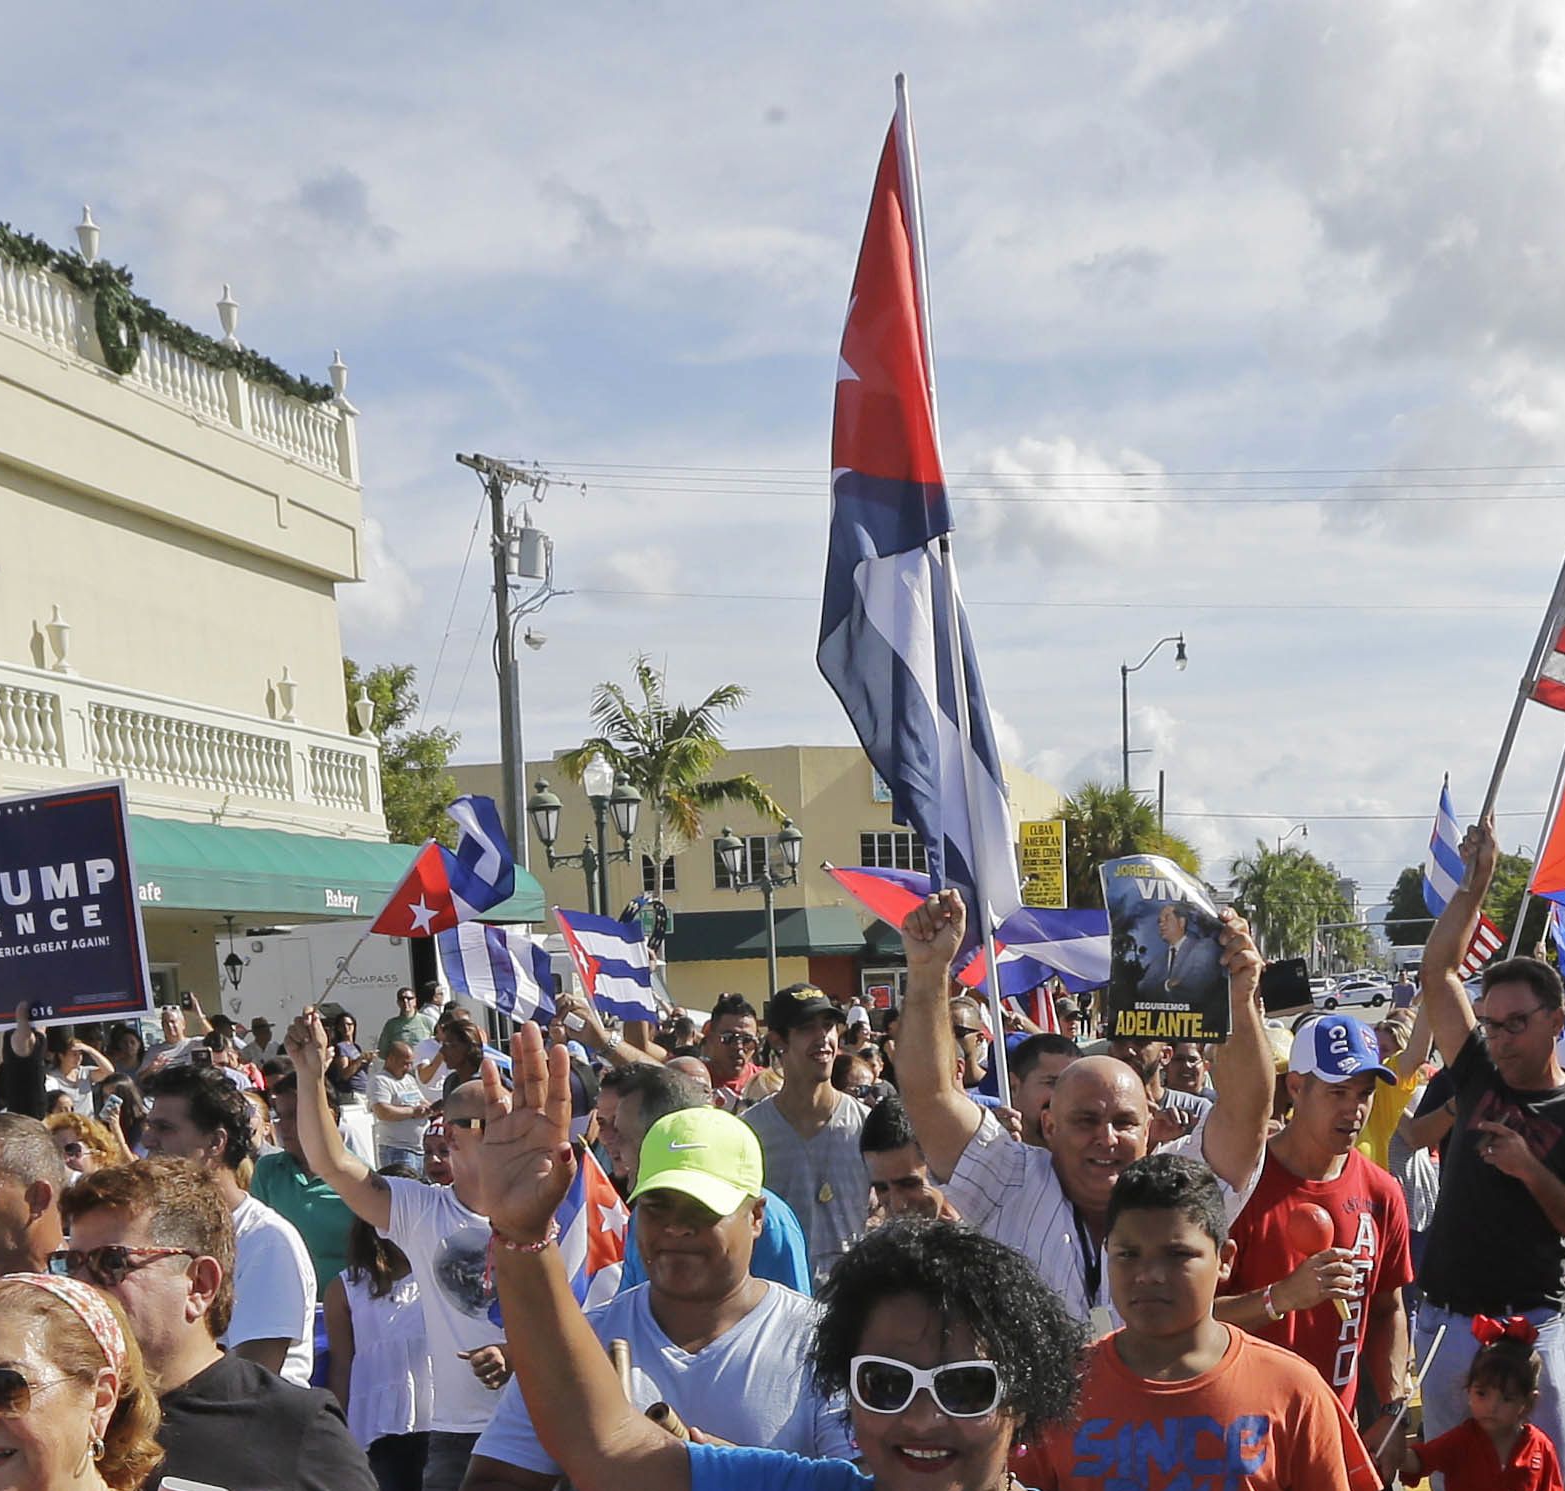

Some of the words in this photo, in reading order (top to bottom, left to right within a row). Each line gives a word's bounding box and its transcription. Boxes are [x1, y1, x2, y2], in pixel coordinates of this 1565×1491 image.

[1114, 865, 1151, 877] JORGE
[325, 889, 358, 913] Bakery
[33, 940, 68, 954] GREAT
[71, 936, 110, 950] AGAIN!
[1135, 1002, 1190, 1011] SEGUIREMOS
[1115, 1010, 1219, 1038] ADELANTE...
[1071, 1415, 1270, 1477] SINCE
